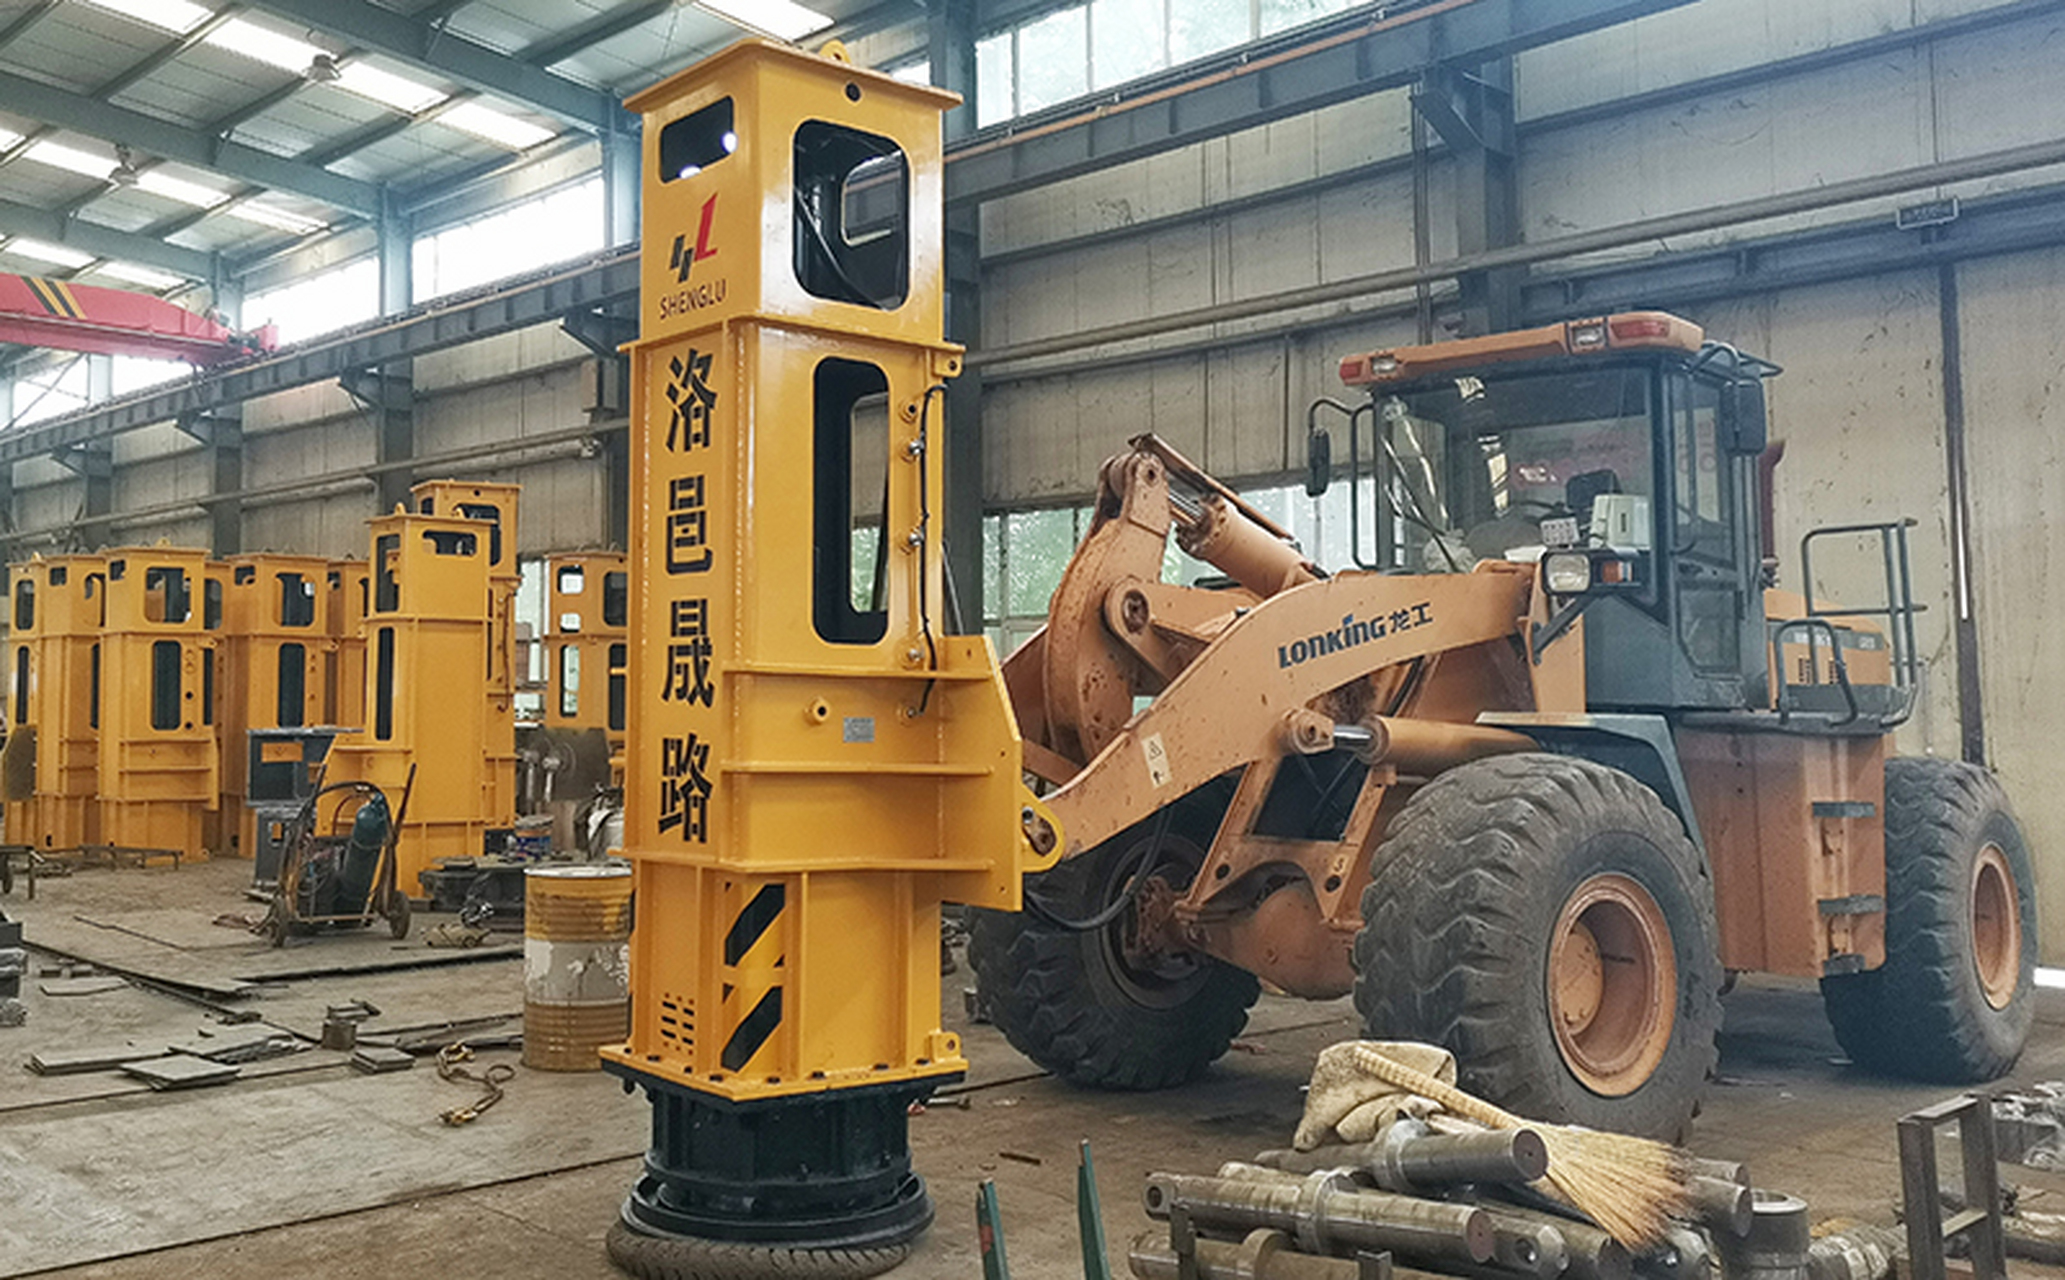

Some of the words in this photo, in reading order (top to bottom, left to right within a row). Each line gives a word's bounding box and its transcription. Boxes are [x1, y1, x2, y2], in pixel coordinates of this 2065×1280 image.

[660, 279, 726, 319] SHENGLU
[659, 349, 718, 843] 洛邑晟路
[1388, 602, 1433, 633] 龙工
